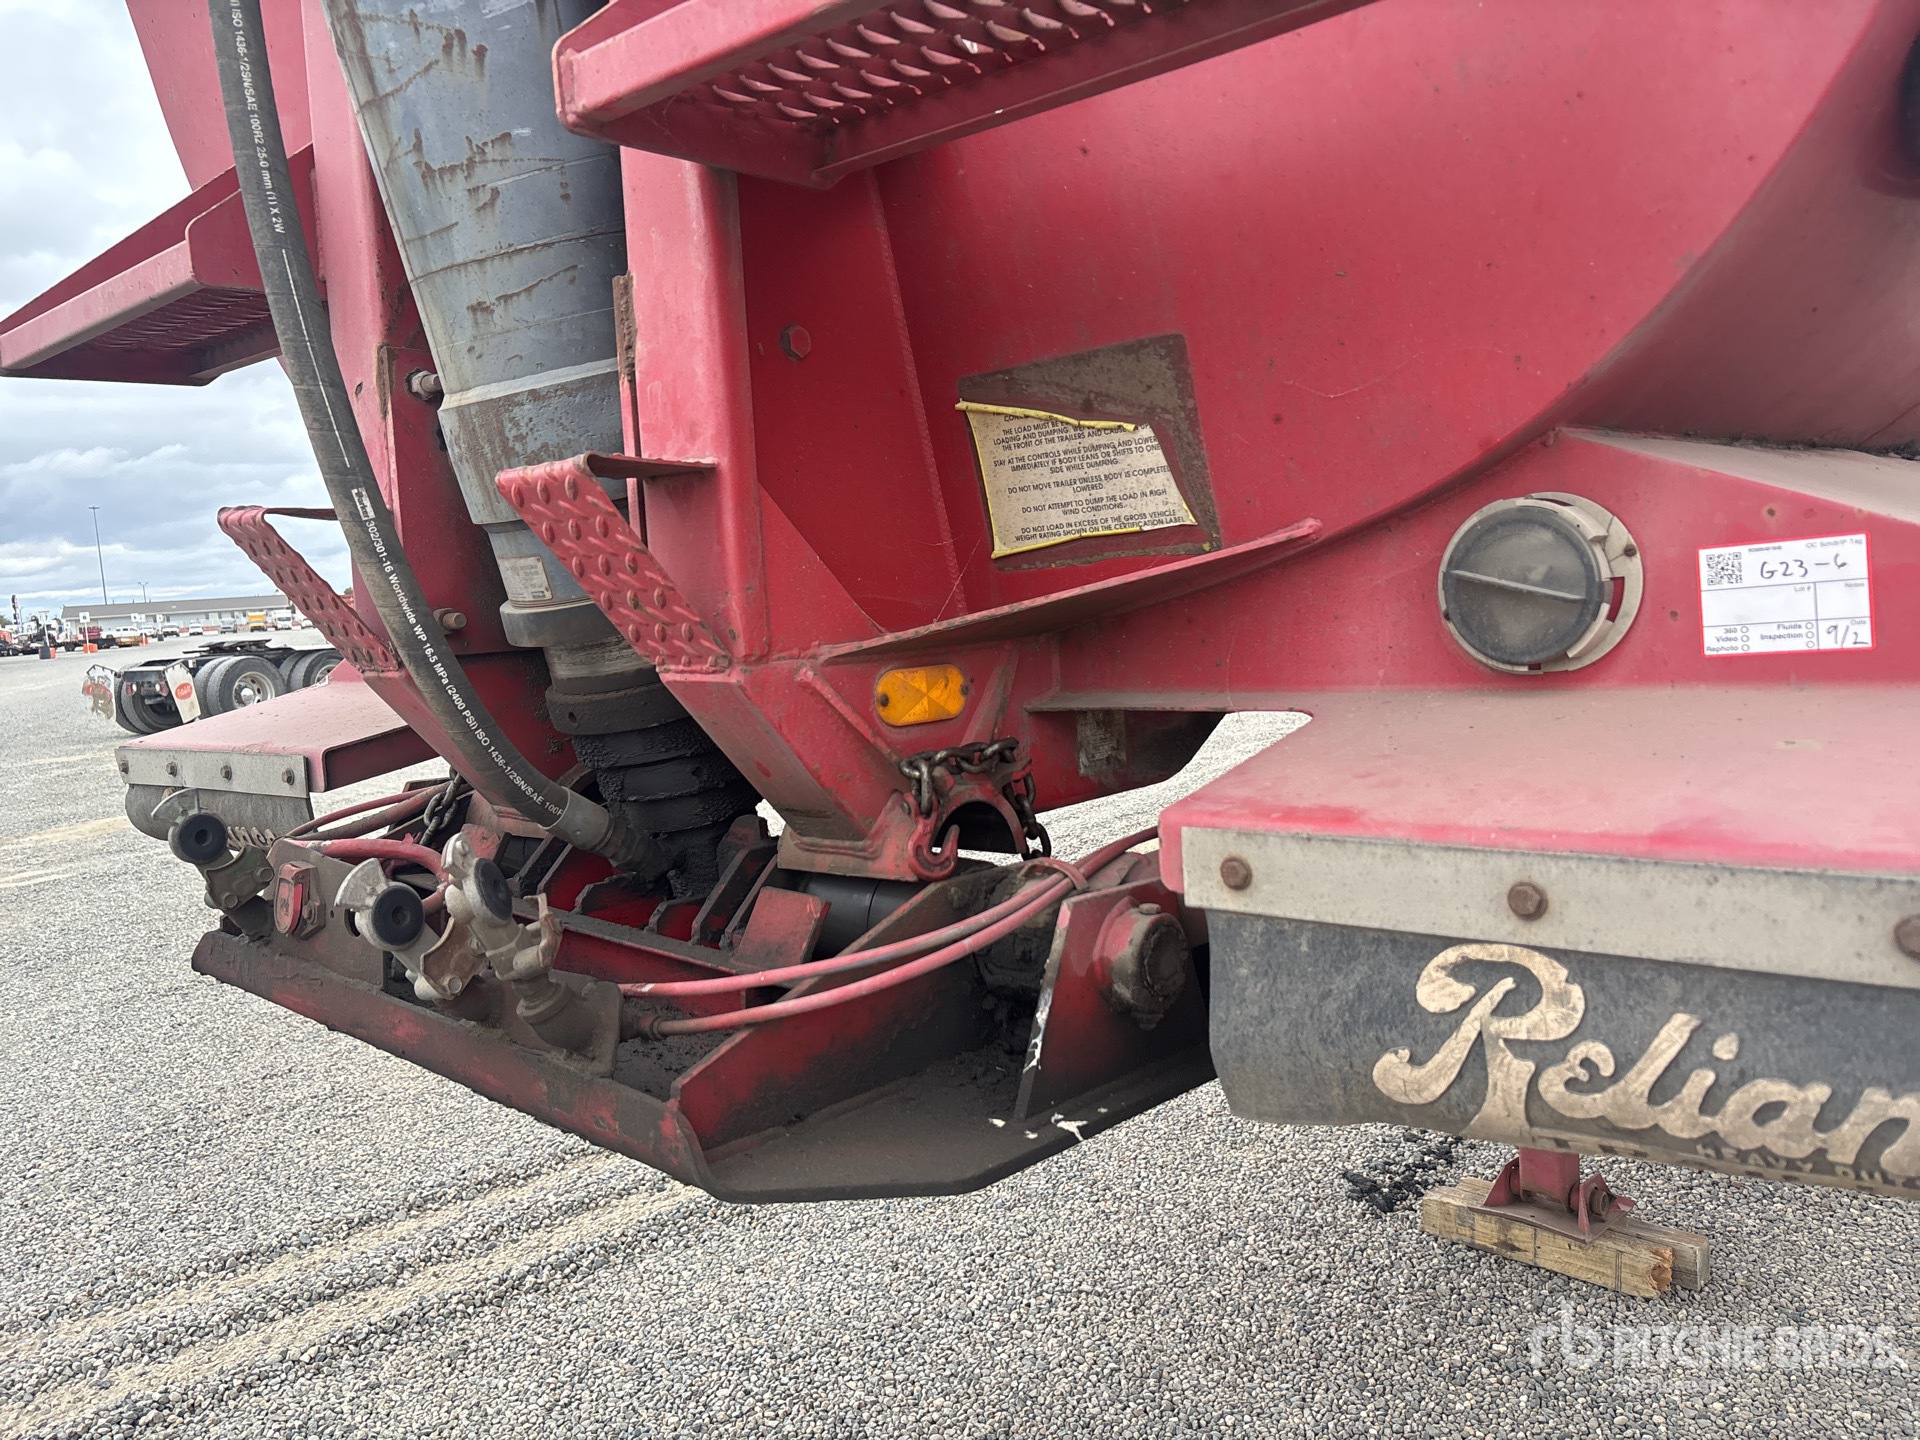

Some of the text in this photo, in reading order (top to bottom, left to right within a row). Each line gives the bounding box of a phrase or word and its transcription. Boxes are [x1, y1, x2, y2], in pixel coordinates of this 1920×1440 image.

[231, 8, 242, 27] ISO
[250, 113, 265, 144] 100R2
[261, 170, 272, 189] mm
[1014, 425, 1031, 434] LOAD
[1033, 422, 1050, 431] MUST
[993, 434, 1020, 445] LOADING
[1022, 432, 1036, 440] AND
[1014, 441, 1032, 450] FRONT
[1034, 438, 1043, 446] OF
[1057, 432, 1085, 442] TRAILERS
[1087, 430, 1102, 438] AND
[1011, 460, 1049, 472] IMMEDIATELY
[1058, 456, 1077, 464] BODY
[1078, 452, 1099, 462] LEANS
[1112, 448, 1133, 457] SHIFTS
[1134, 445, 1144, 453] TO
[1145, 443, 1160, 452] ONE
[1015, 455, 1026, 463] THE
[1027, 450, 1060, 462] CONTROLS
[1061, 447, 1082, 455] WHILE
[1117, 439, 1132, 448] AND
[1065, 463, 1084, 472] WHILE
[1018, 484, 1031, 492] NOT
[1032, 482, 1052, 490] MOVE
[1052, 479, 1077, 488] TRAILER
[1078, 475, 1101, 484] UNLESS
[1103, 472, 1122, 480] BODY
[1033, 504, 1046, 512] NOT
[1047, 501, 1074, 510] ATTEMPT
[1085, 497, 1104, 505] DUMP
[1106, 494, 1117, 502] THE
[1119, 492, 1138, 501] LOAD
[1139, 490, 1147, 498] IN
[1149, 488, 1167, 497] HIGH
[1073, 519, 1098, 527] EXCESS
[1123, 512, 1147, 521] GROSS
[1148, 509, 1176, 518] VEHICLE
[1014, 533, 1037, 542] WEIGHT
[1038, 530, 1061, 539] RATING
[1062, 527, 1087, 536] SHOWN
[1101, 524, 1112, 532] THE
[1114, 519, 1164, 530] CERTIFICATION
[1759, 632, 1803, 641] Inspection
[365, 520, 393, 572] 302/301-16
[388, 573, 416, 624] Worldwide
[413, 624, 427, 642] WP
[433, 662, 448, 685] MPa
[445, 684, 466, 709] (2400
[462, 709, 478, 730] PSI)
[474, 728, 490, 746] ISO
[488, 745, 544, 804] 1436-1/2SN/SAE
